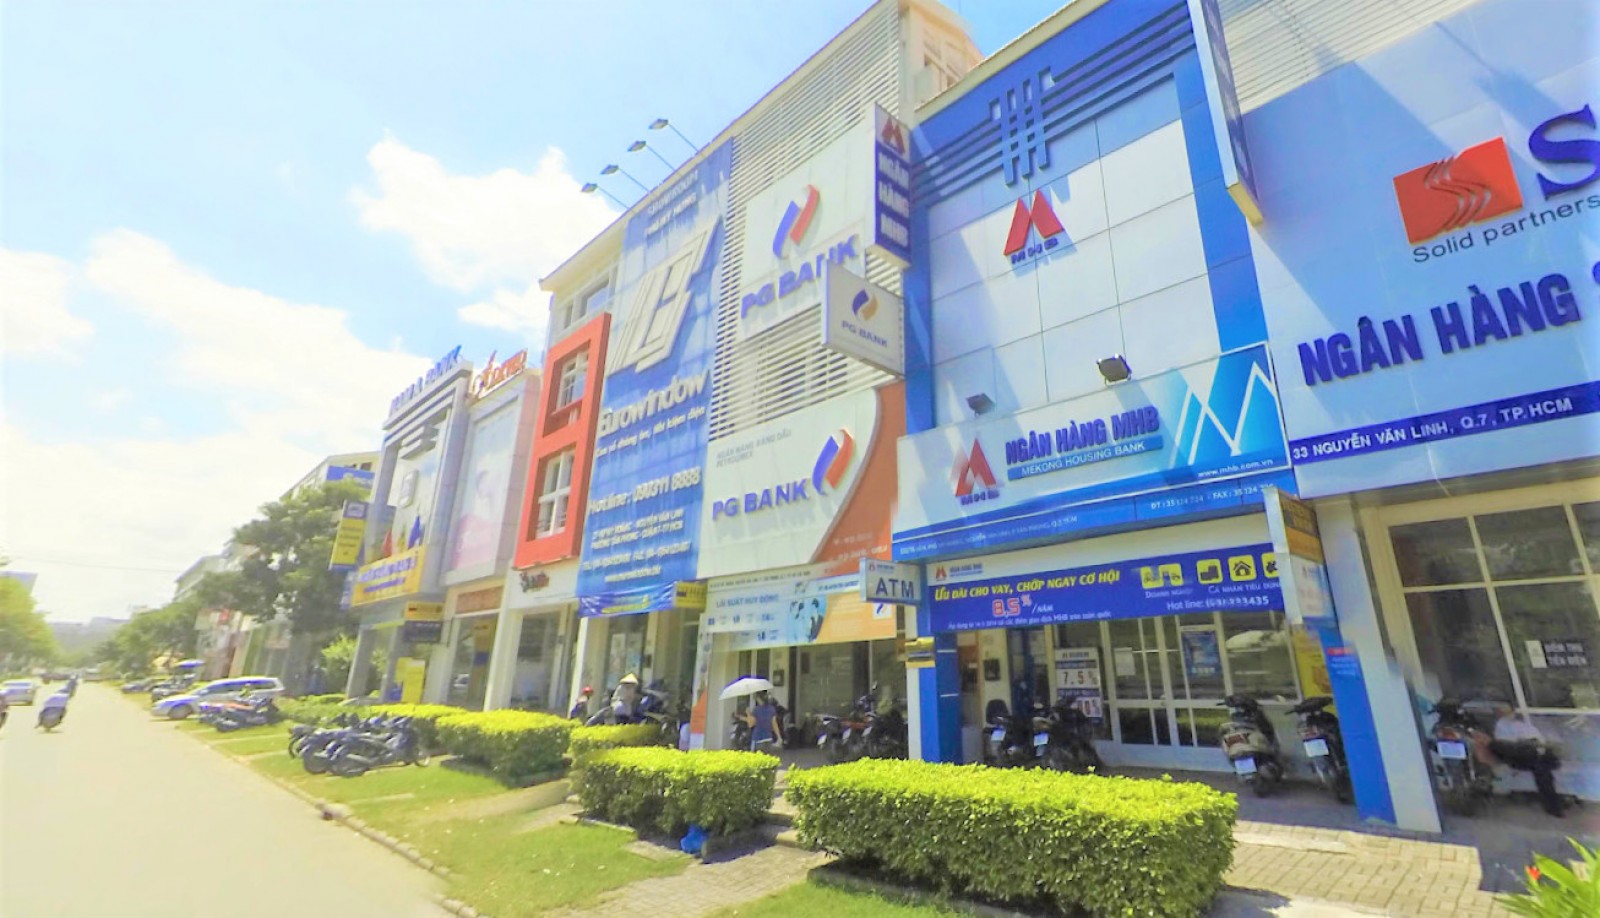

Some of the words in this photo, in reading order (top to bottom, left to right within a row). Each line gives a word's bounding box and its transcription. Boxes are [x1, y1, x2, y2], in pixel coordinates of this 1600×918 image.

[1413, 232, 1474, 263] Solid
[741, 283, 775, 319] PG
[841, 320, 857, 333] PG
[859, 329, 887, 348] BANK
[1298, 313, 1423, 386] NGÂN
[1430, 273, 1582, 355] HÀNG
[600, 370, 709, 438] Eurowindow
[1005, 430, 1051, 465] NGÂN
[1056, 420, 1107, 453] HÀNG
[1111, 405, 1160, 441] MHB
[1293, 446, 1308, 459] 33
[1313, 432, 1371, 457] NGUYỄN
[1375, 427, 1405, 444] VĂN
[1021, 458, 1062, 475] MEKONG
[1066, 448, 1112, 467] HOUSING
[1115, 441, 1145, 455] BANK
[712, 497, 739, 521] PG
[744, 478, 810, 514] BANK
[875, 577, 915, 598] ATM
[970, 587, 989, 597] CHO
[992, 584, 1014, 595] VAY,
[1016, 579, 1044, 593] CHỚP
[1047, 575, 1076, 588] NGAY
[1080, 572, 1095, 584] CƠ
[1098, 570, 1120, 585] HỘI
[727, 595, 744, 607] SUẤT
[745, 594, 758, 605] HUY
